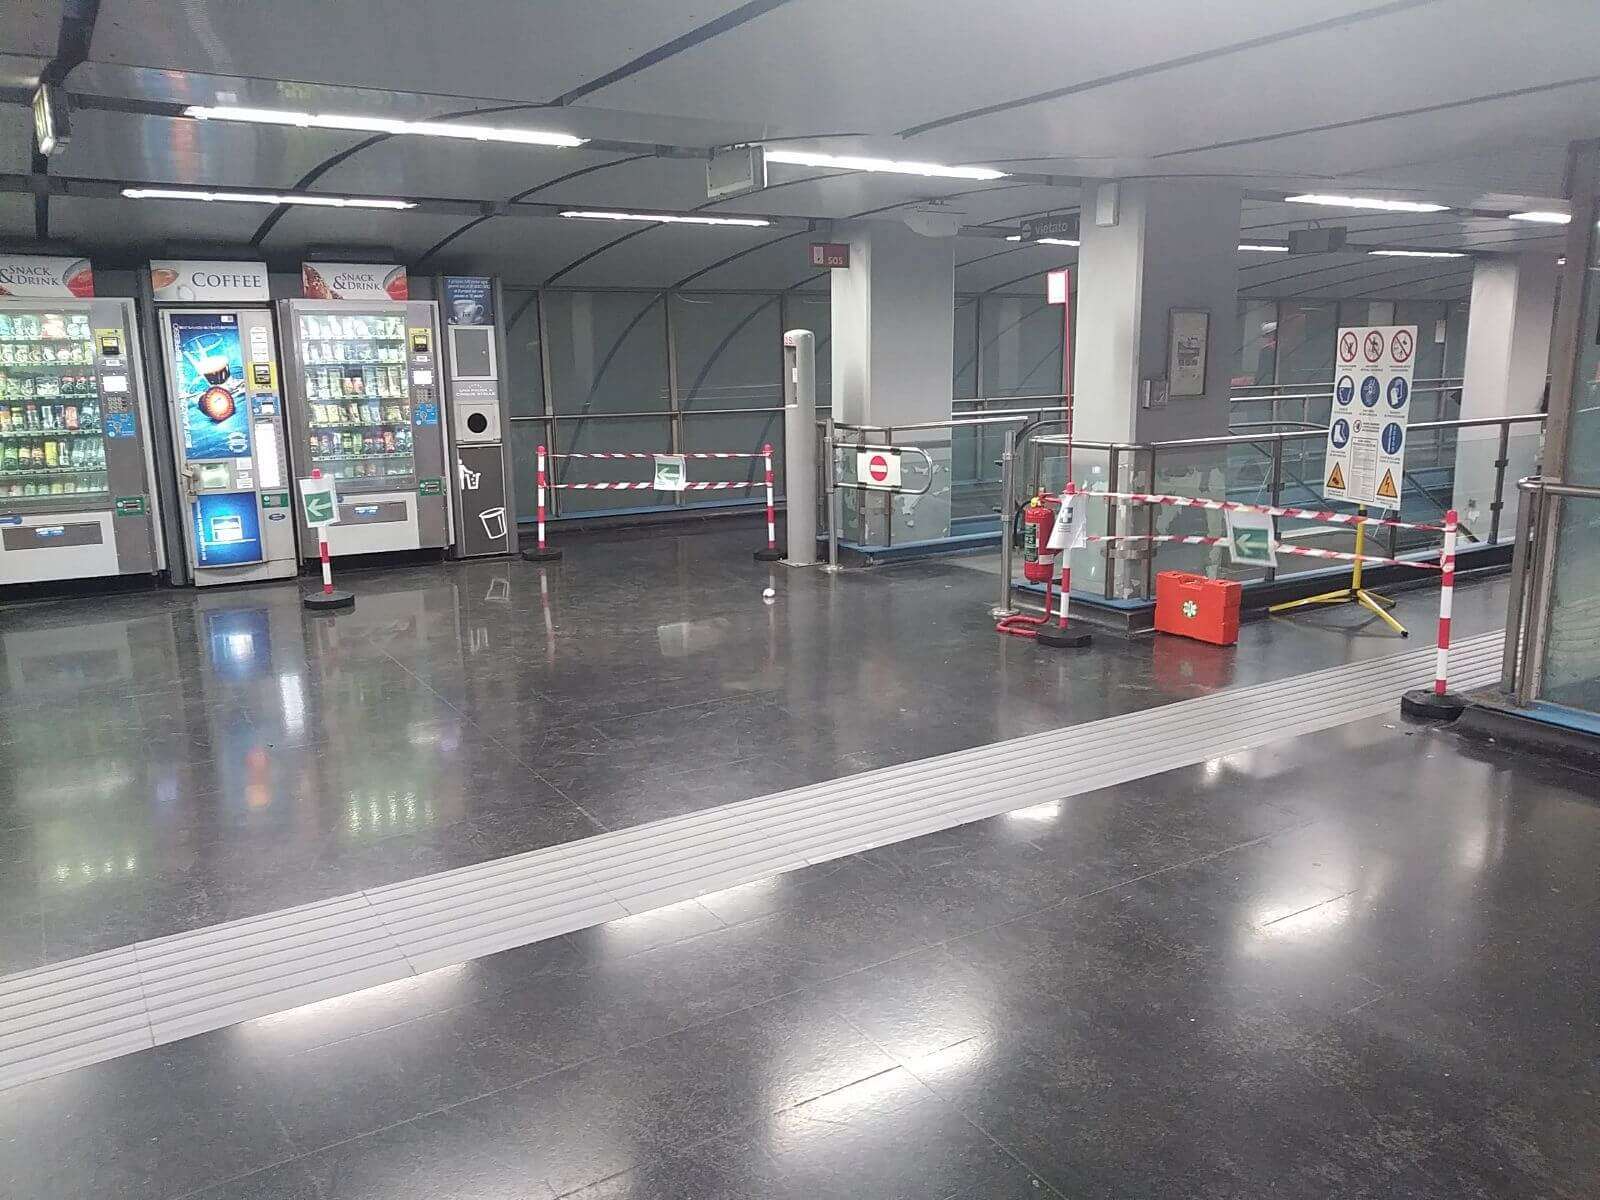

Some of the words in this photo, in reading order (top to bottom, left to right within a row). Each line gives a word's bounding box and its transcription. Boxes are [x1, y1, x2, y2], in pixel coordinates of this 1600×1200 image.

[827, 257, 843, 265] SOS
[0, 268, 15, 284] &
[17, 274, 61, 286] DRINK
[9, 264, 52, 276] SNACK
[191, 272, 262, 288] COFFEE
[333, 275, 346, 290] &
[347, 281, 383, 291] DRINK
[342, 272, 375, 283] SNACK
